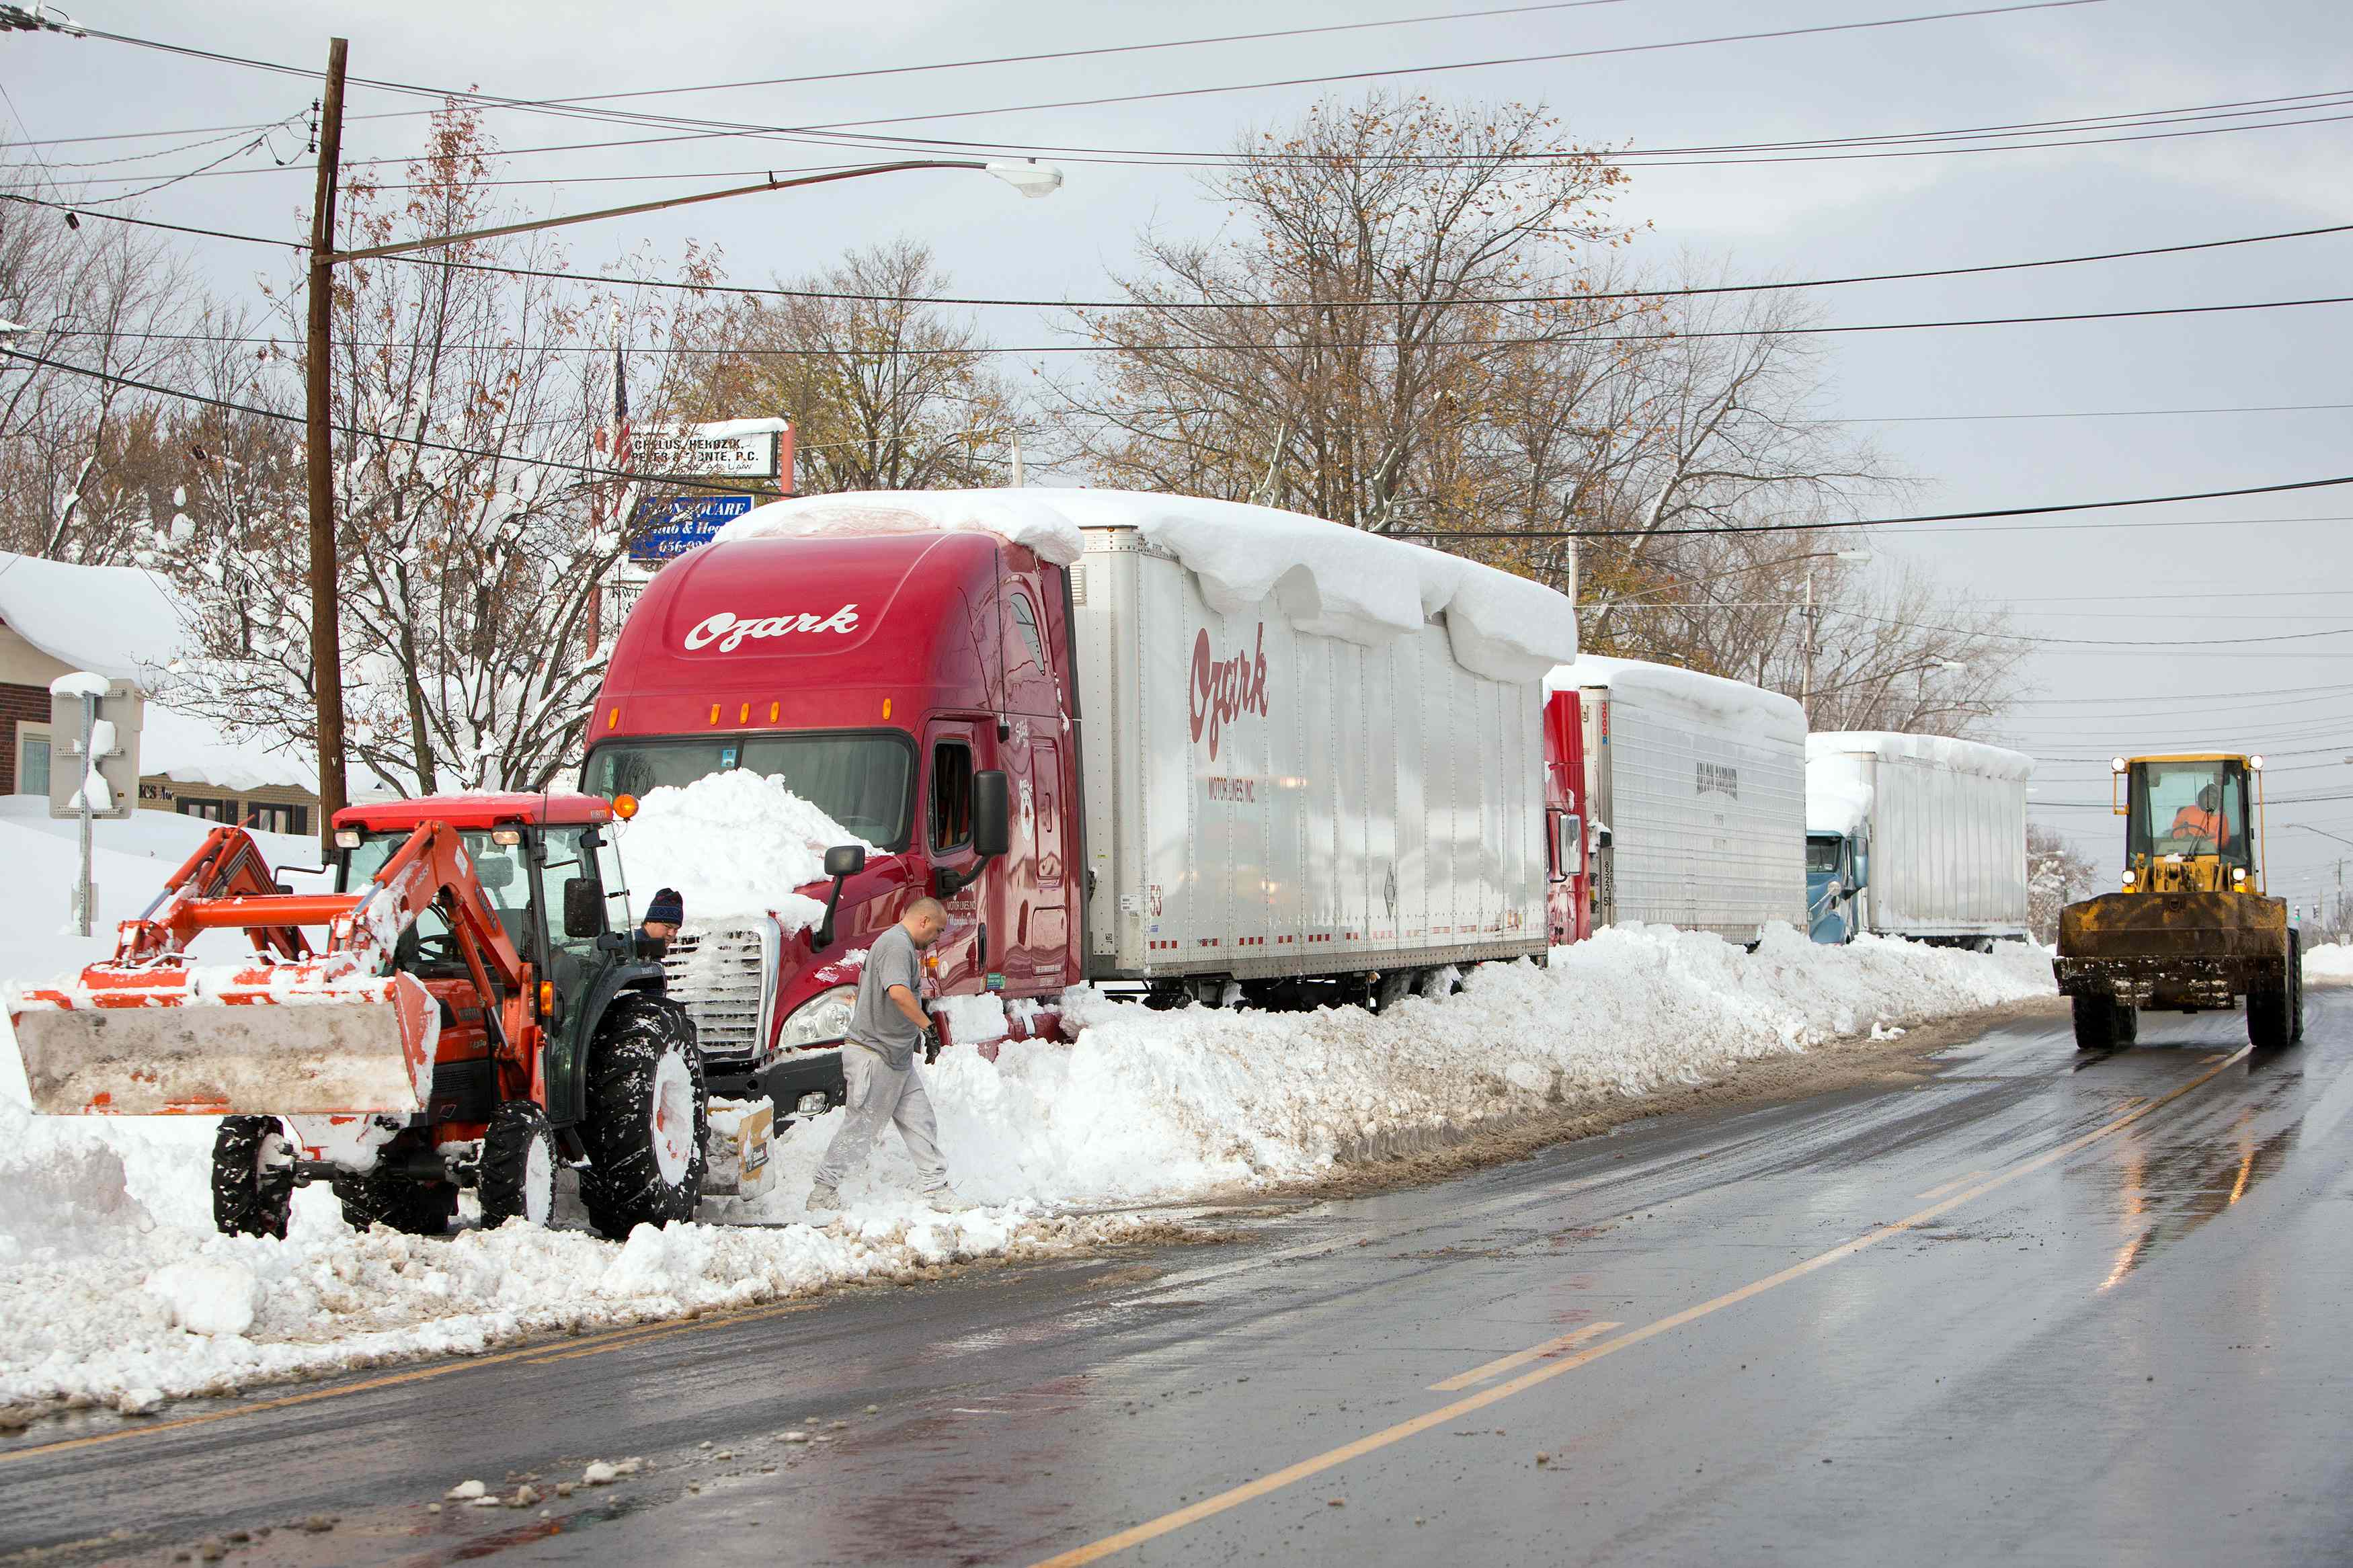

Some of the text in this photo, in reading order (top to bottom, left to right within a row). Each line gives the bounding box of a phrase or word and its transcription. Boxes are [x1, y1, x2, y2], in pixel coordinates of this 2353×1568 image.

[684, 604, 859, 653] Ozark
[1190, 622, 1269, 762] Ozark
[1209, 776, 1227, 801] MOTOR
[1150, 884, 1162, 917] 53
